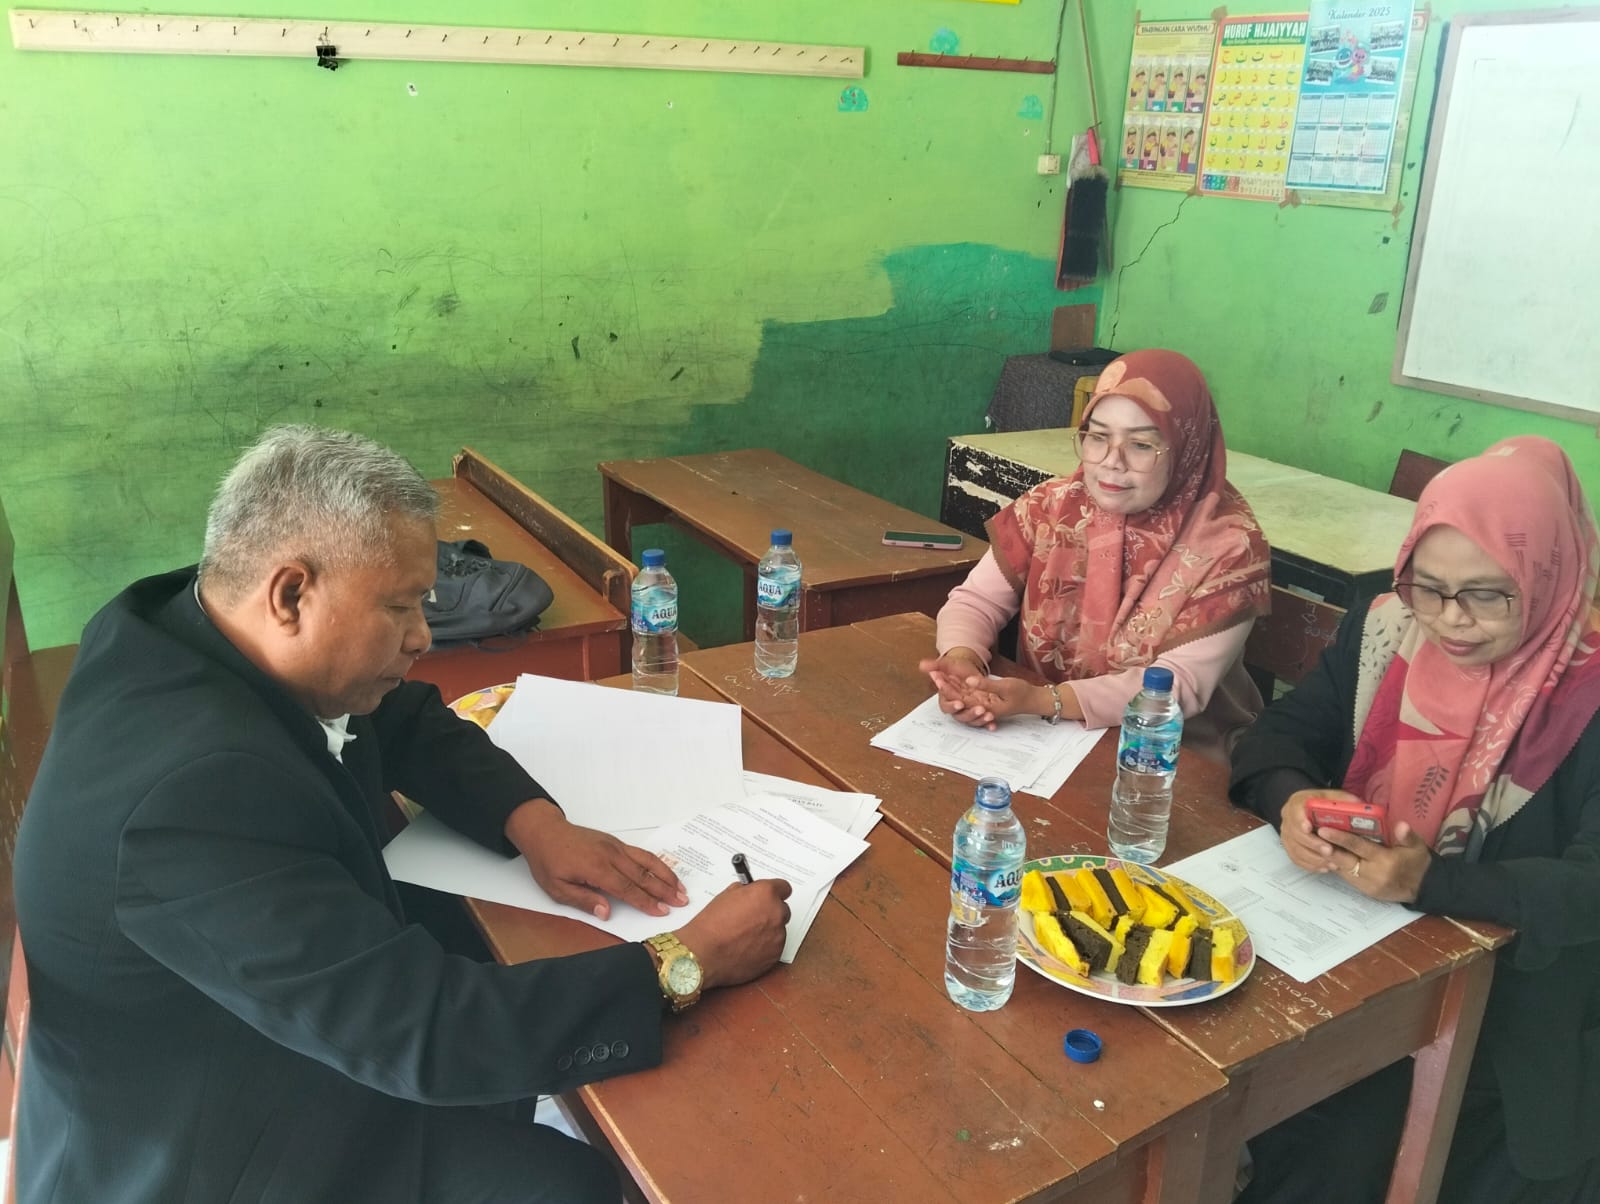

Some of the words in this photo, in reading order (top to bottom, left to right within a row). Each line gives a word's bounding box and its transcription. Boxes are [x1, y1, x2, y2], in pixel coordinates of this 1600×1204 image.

[1328, 8, 1365, 20] Kalender
[1368, 7, 1391, 17] 2025
[1224, 24, 1252, 39] HURUF
[1254, 22, 1307, 38] HIJAIYYAH
[758, 582, 782, 596] AQUA
[652, 606, 678, 620] AQUA
